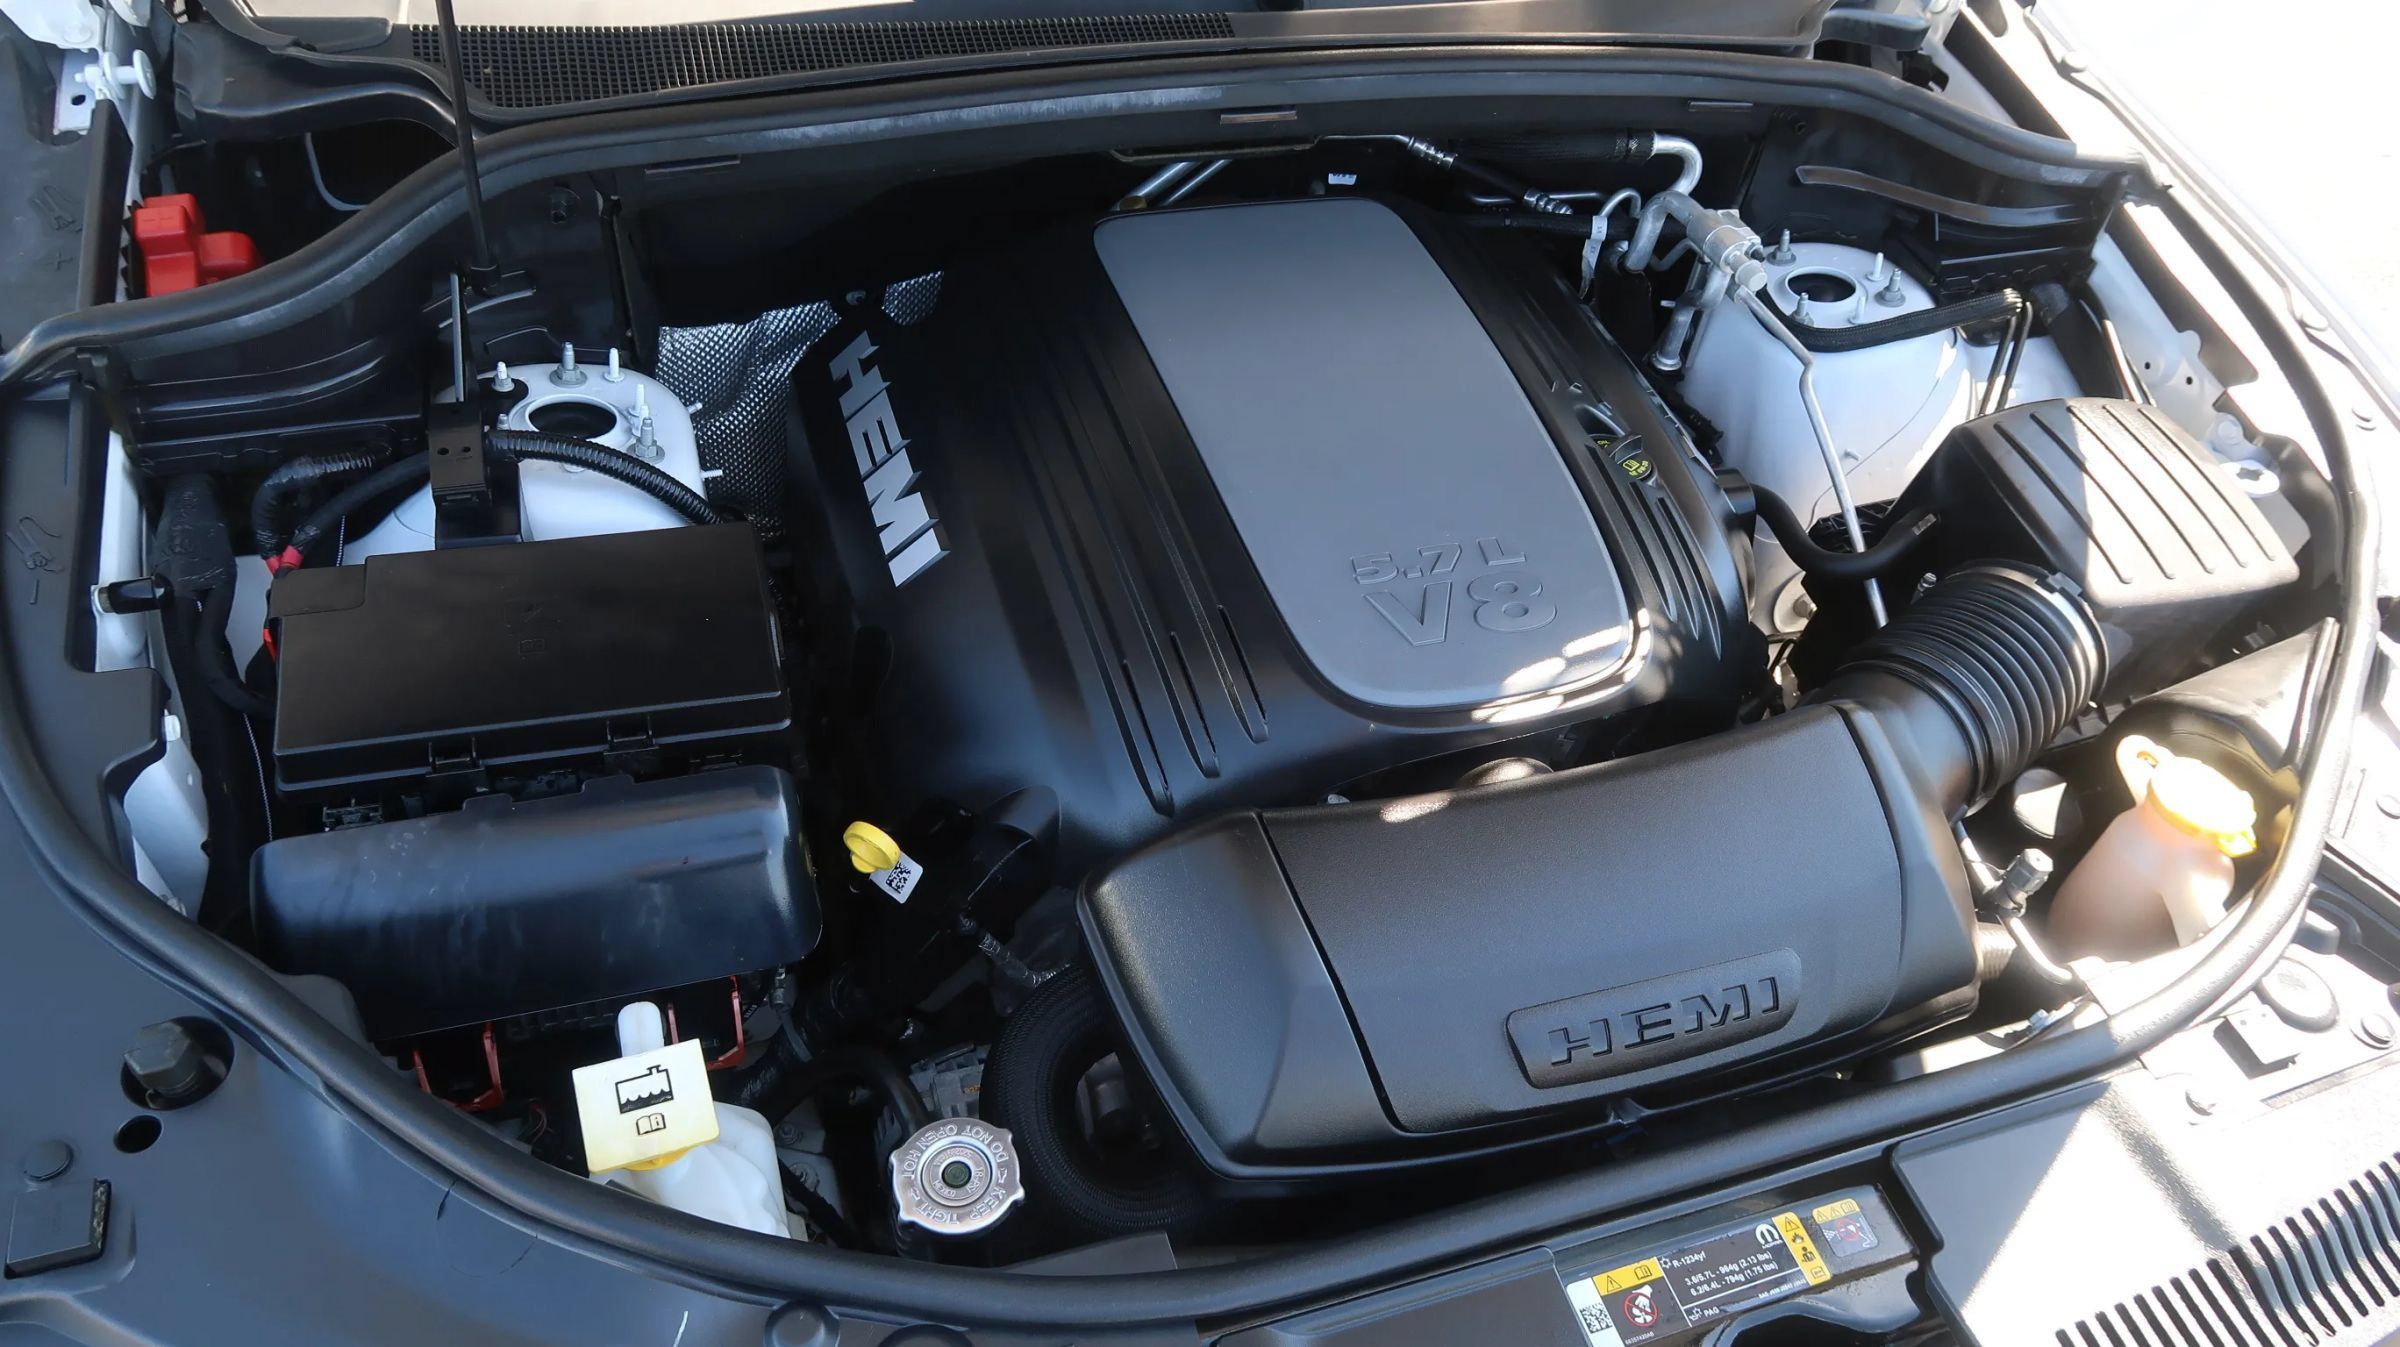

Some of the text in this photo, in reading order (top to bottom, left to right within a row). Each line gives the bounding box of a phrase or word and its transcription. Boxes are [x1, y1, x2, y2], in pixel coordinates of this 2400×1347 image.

[829, 330, 950, 588] HEMI
[1350, 537, 1526, 585] 5.7L
[1362, 571, 1557, 647] V8
[1548, 976, 1779, 1066] HEMI
[916, 1124, 958, 1151] OPEN
[961, 1125, 994, 1145] NOT
[902, 1149, 922, 1181] HOT
[990, 1142, 1009, 1163] DO
[913, 1202, 960, 1225] TIGHT
[969, 1186, 1007, 1221] KEEP
